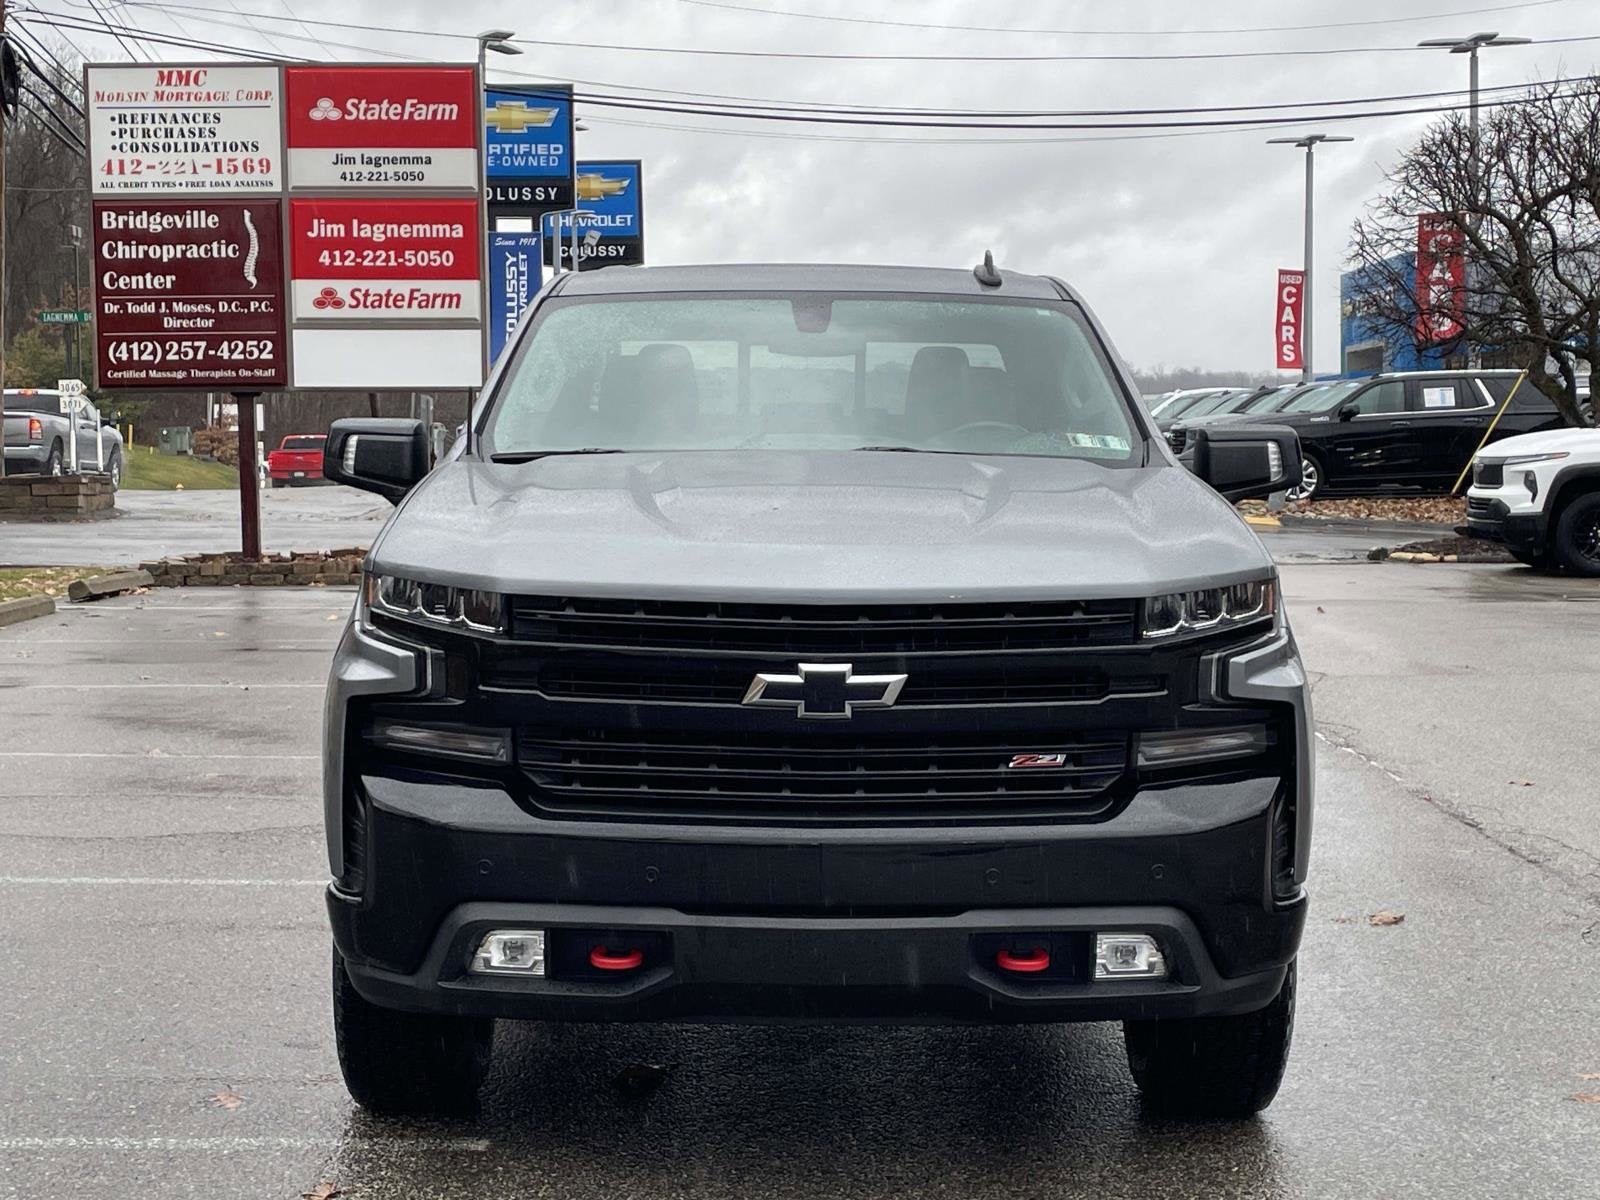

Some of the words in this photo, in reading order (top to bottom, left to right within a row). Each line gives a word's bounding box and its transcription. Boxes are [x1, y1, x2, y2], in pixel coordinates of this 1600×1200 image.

[155, 69, 207, 87] MMC
[101, 157, 271, 175] 412-221-1569
[332, 153, 356, 166] Jim
[361, 153, 432, 168] Iagnemma
[100, 181, 115, 189] ALL
[118, 181, 149, 189] CREDIT
[185, 180, 206, 188] FREE
[209, 180, 231, 188] LOAN
[234, 180, 274, 188] ANALYSIS
[340, 170, 425, 182] 412-221-5050
[102, 209, 219, 232] Bridgeville
[306, 219, 345, 238] Jim
[352, 219, 464, 242] Iagnemma
[102, 240, 240, 262] Chiropractic
[319, 250, 454, 268] 412-221-5050
[103, 271, 176, 290] Center
[1280, 275, 1303, 284] USED
[104, 302, 123, 314] Dr.
[126, 302, 155, 314] Todd
[159, 302, 169, 313] J.
[172, 302, 215, 314] Moses,
[250, 301, 274, 313] P.C.
[163, 316, 215, 328] Director
[1281, 286, 1297, 362] CARS
[107, 369, 146, 379] Certified
[149, 369, 187, 379] Massage
[190, 368, 236, 379] Therapists
[238, 368, 276, 378] On-Staff
